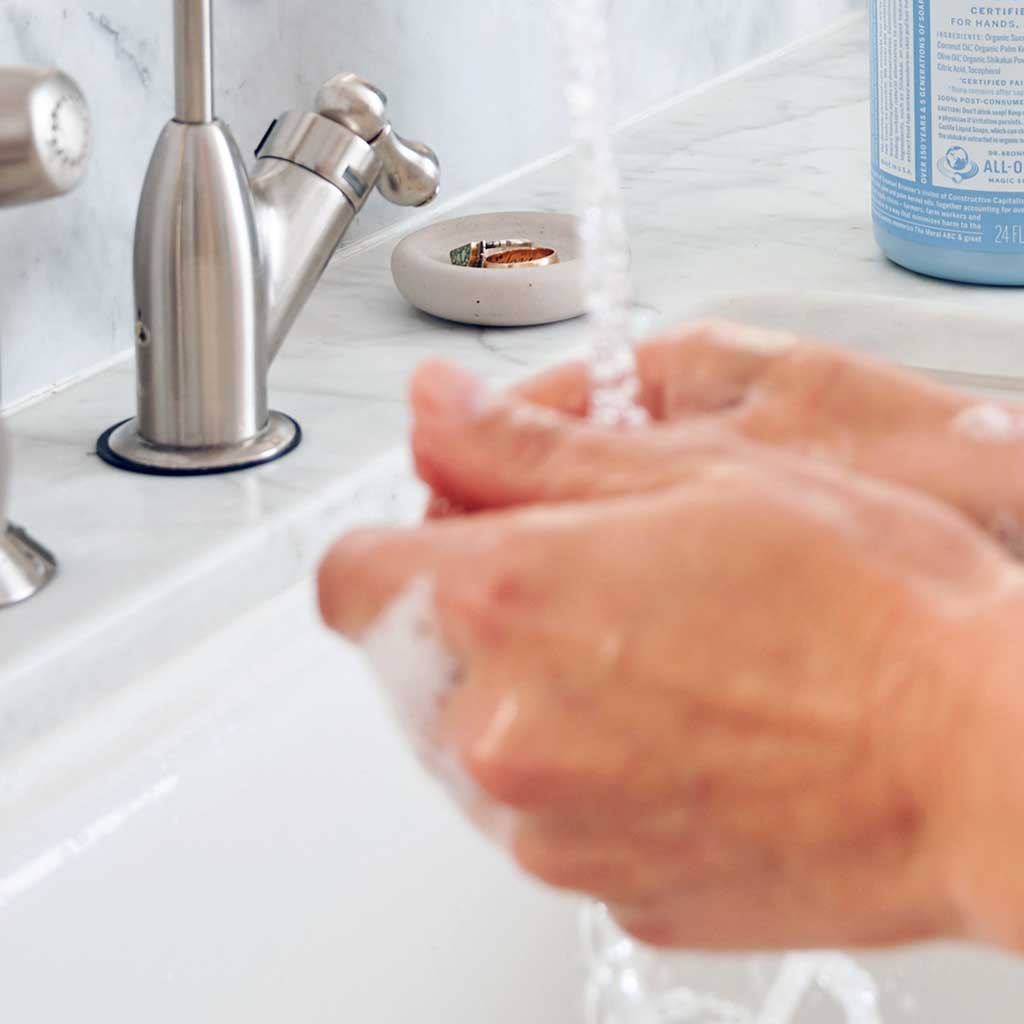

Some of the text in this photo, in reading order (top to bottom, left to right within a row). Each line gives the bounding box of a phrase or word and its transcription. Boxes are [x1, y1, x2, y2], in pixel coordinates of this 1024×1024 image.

[917, 0, 926, 22] SOAP
[951, 17, 972, 26] FOR
[918, 24, 926, 35] OF
[918, 37, 927, 98] GENERATIONS
[919, 116, 927, 143] YEARS
[920, 161, 928, 185] OVER
[994, 224, 1010, 244] 24
